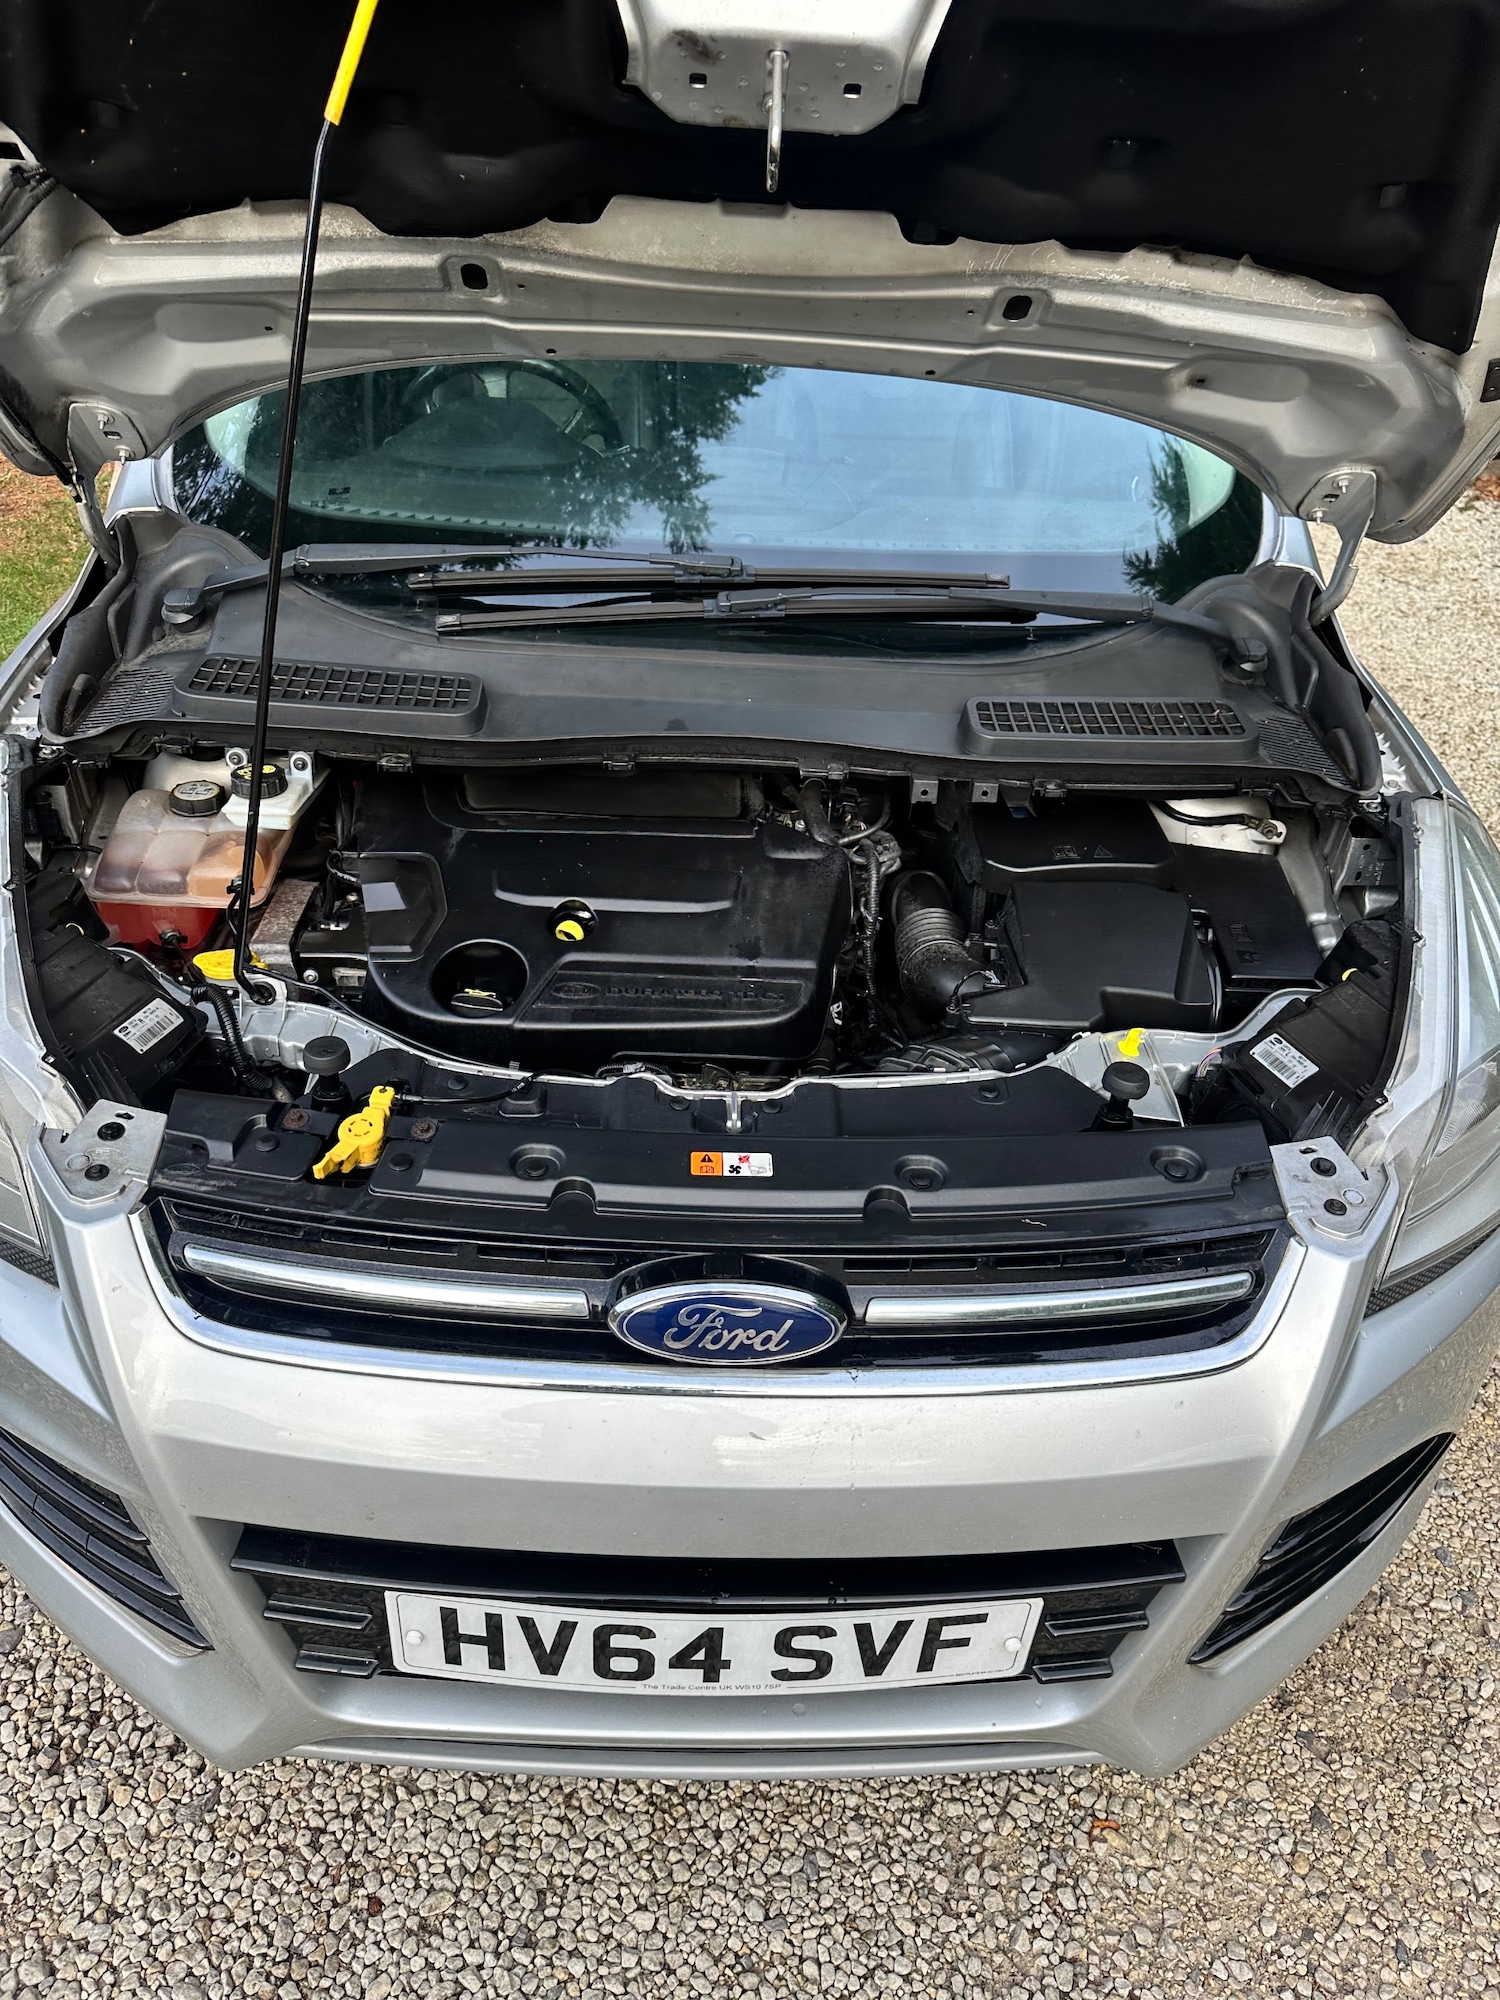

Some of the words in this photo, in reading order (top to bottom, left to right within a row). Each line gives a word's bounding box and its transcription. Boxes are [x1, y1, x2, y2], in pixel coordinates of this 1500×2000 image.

[606, 987, 723, 1000] DURA
[663, 1303, 794, 1351] Ford
[440, 1606, 731, 1683] HV64
[770, 1612, 989, 1682] SVF
